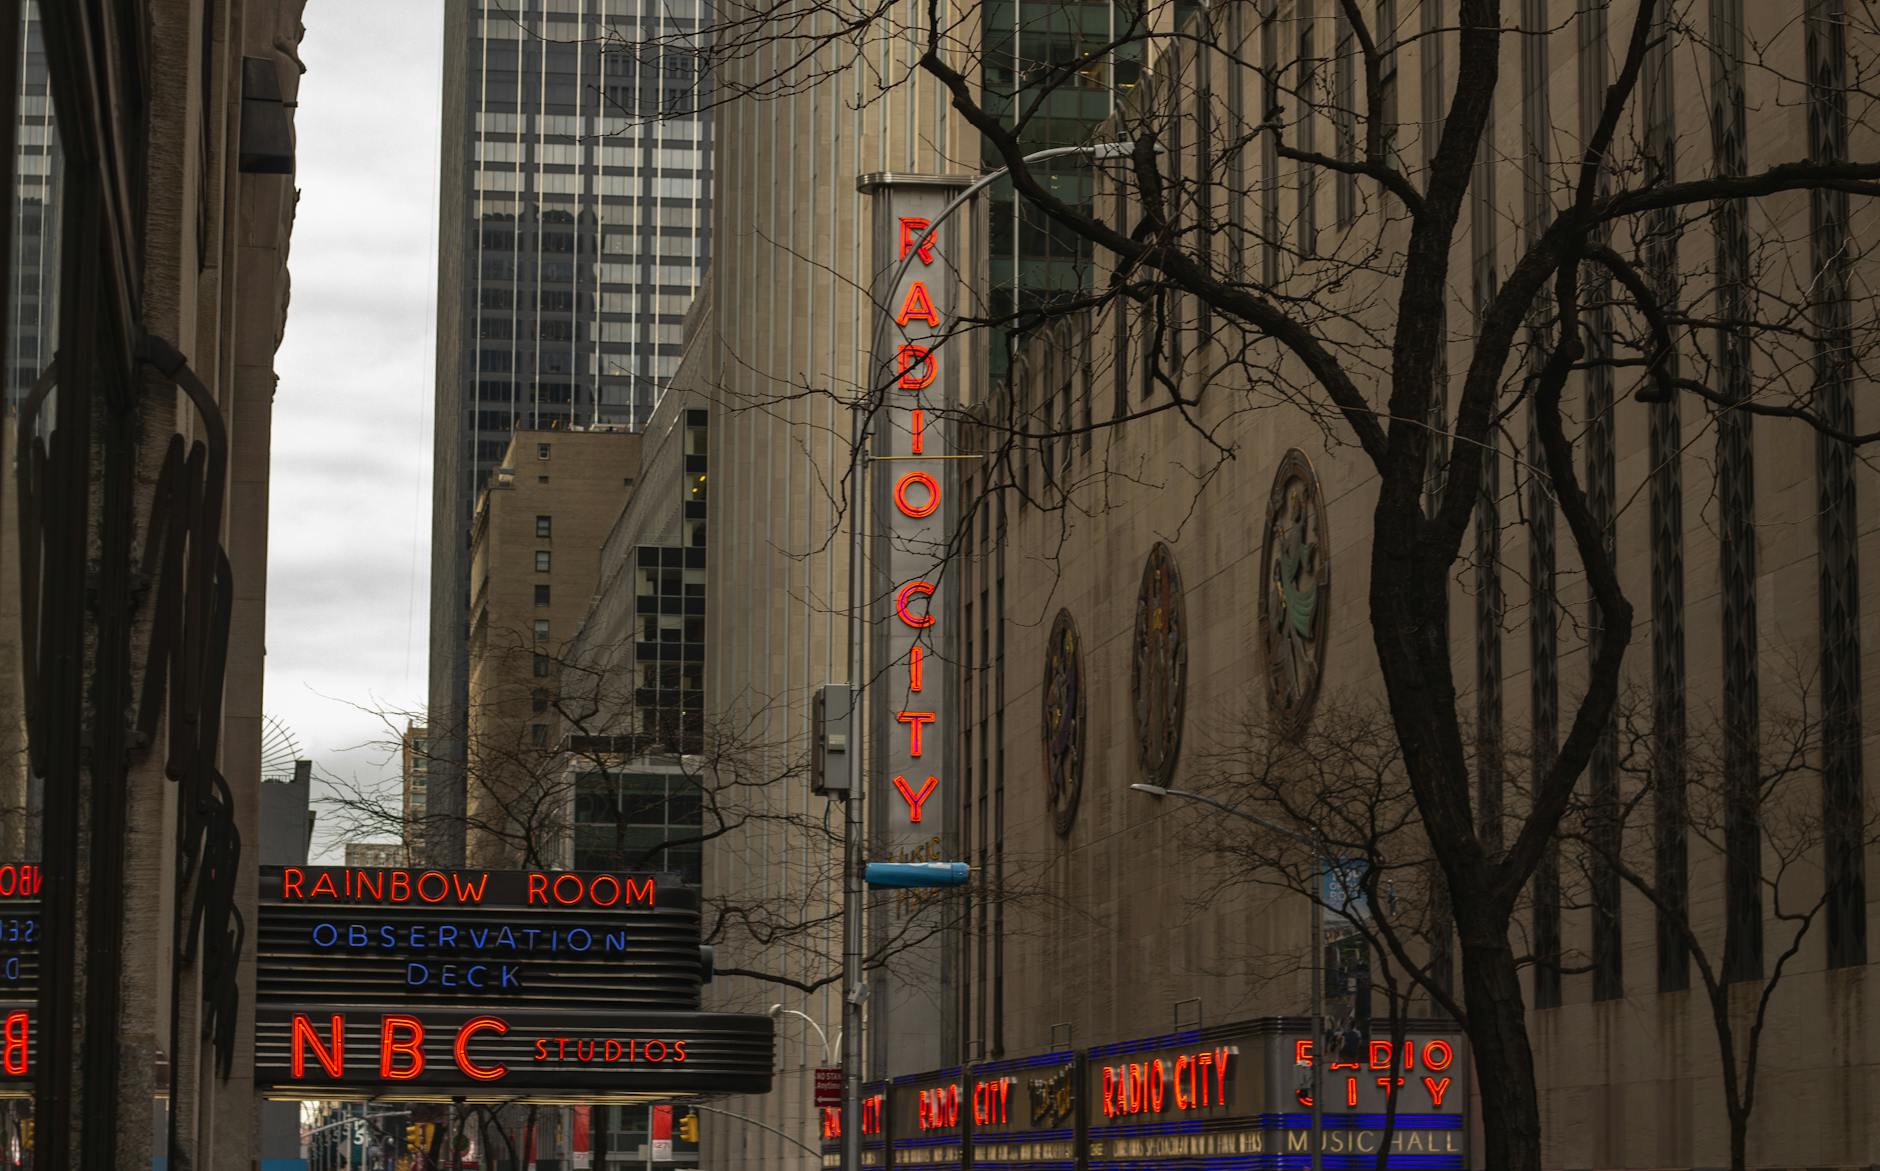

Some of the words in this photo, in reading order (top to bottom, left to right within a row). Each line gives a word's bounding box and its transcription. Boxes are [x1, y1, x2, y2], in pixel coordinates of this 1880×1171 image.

[892, 216, 942, 518] RADIO
[892, 580, 940, 822] CITY
[284, 868, 488, 903] RAINBOW
[528, 872, 656, 907] ROOM
[313, 922, 627, 951] OBSERVATION
[407, 963, 523, 988] DECK
[291, 1013, 510, 1080] NBC
[535, 1037, 687, 1062] STUDIOS
[1295, 1039, 1453, 1071] RDIO
[919, 1083, 960, 1131] RADIO
[973, 1077, 1010, 1127] CITY
[1102, 1058, 1168, 1118] RADIO
[1174, 1046, 1232, 1111] CITY
